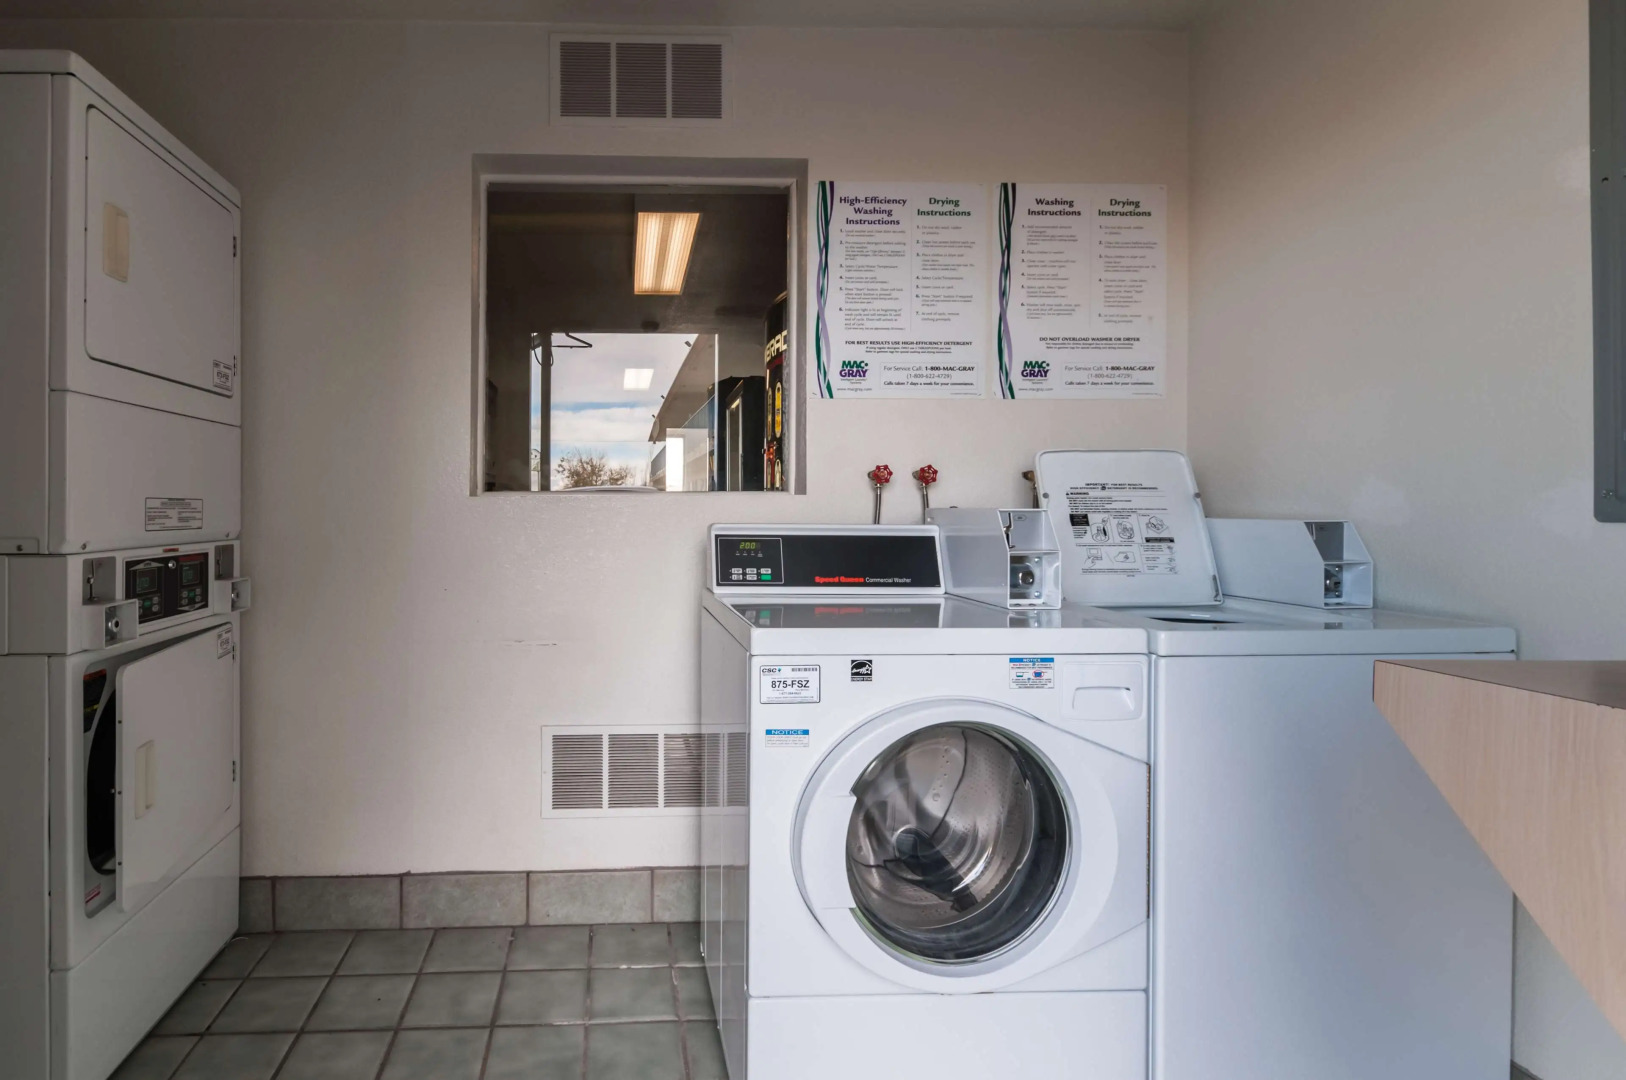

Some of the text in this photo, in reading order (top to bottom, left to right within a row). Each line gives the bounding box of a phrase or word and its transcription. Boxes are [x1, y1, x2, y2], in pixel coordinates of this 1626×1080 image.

[840, 196, 907, 206] High-Efficiency
[929, 197, 960, 207] Drying
[1035, 198, 1074, 208] Washing
[1110, 199, 1140, 208] Drying
[854, 207, 893, 216] Washing
[839, 369, 868, 377] GRAY
[1021, 369, 1049, 378] GRAY
[771, 680, 809, 688] 875-FSZ
